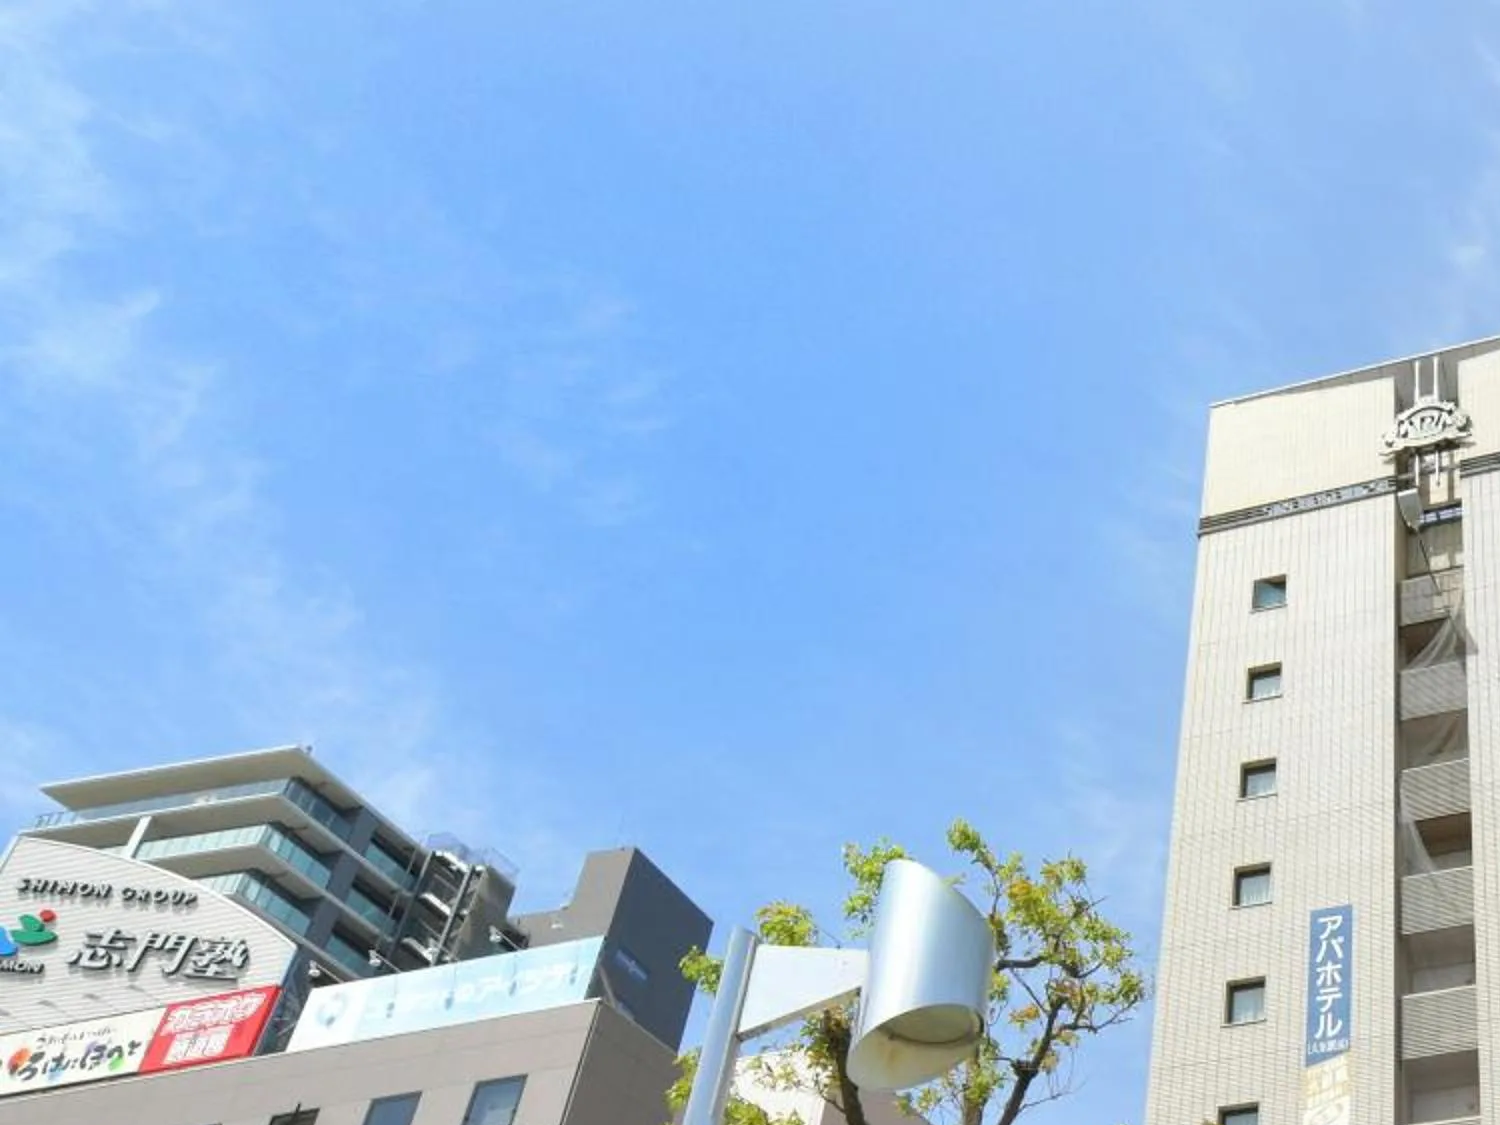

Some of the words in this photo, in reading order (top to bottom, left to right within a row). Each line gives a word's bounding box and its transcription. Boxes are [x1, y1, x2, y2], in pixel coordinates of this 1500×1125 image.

[16, 878, 113, 899] SHIMON
[121, 887, 199, 906] GROUP
[67, 929, 250, 980] 志門塾
[1314, 915, 1345, 1039] アパホテル
